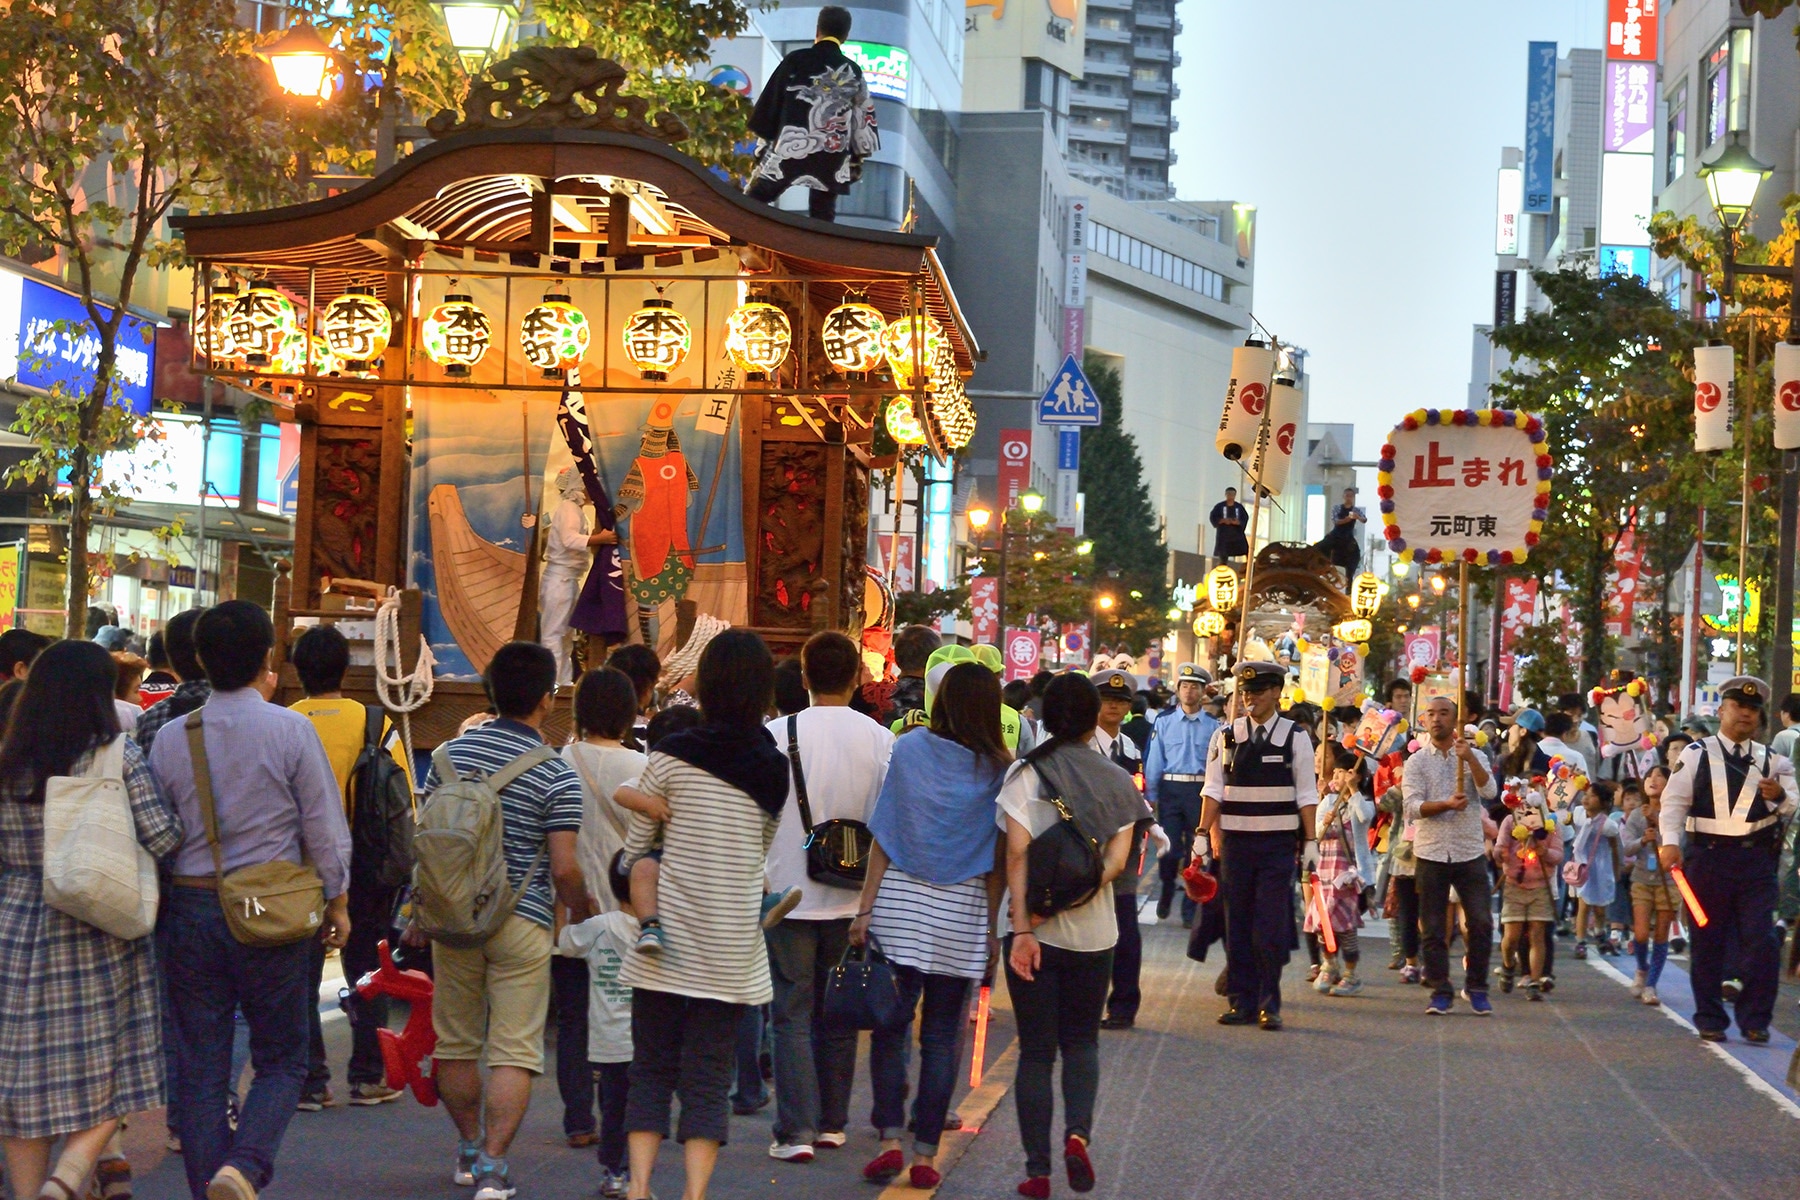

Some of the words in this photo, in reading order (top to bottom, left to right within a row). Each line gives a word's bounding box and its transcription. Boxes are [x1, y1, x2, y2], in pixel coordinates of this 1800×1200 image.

[1527, 194, 1548, 207] 5F
[231, 293, 279, 354] 本町
[326, 299, 379, 356] 本町
[446, 306, 489, 363] 本町
[523, 308, 559, 365] 本町
[632, 311, 684, 364] 本町
[743, 309, 790, 369] 本町
[824, 308, 871, 367] 本町
[705, 351, 736, 420] 清正
[1408, 441, 1528, 488] 止まれ
[1430, 515, 1498, 538] 元町東
[1013, 638, 1034, 662] 祭
